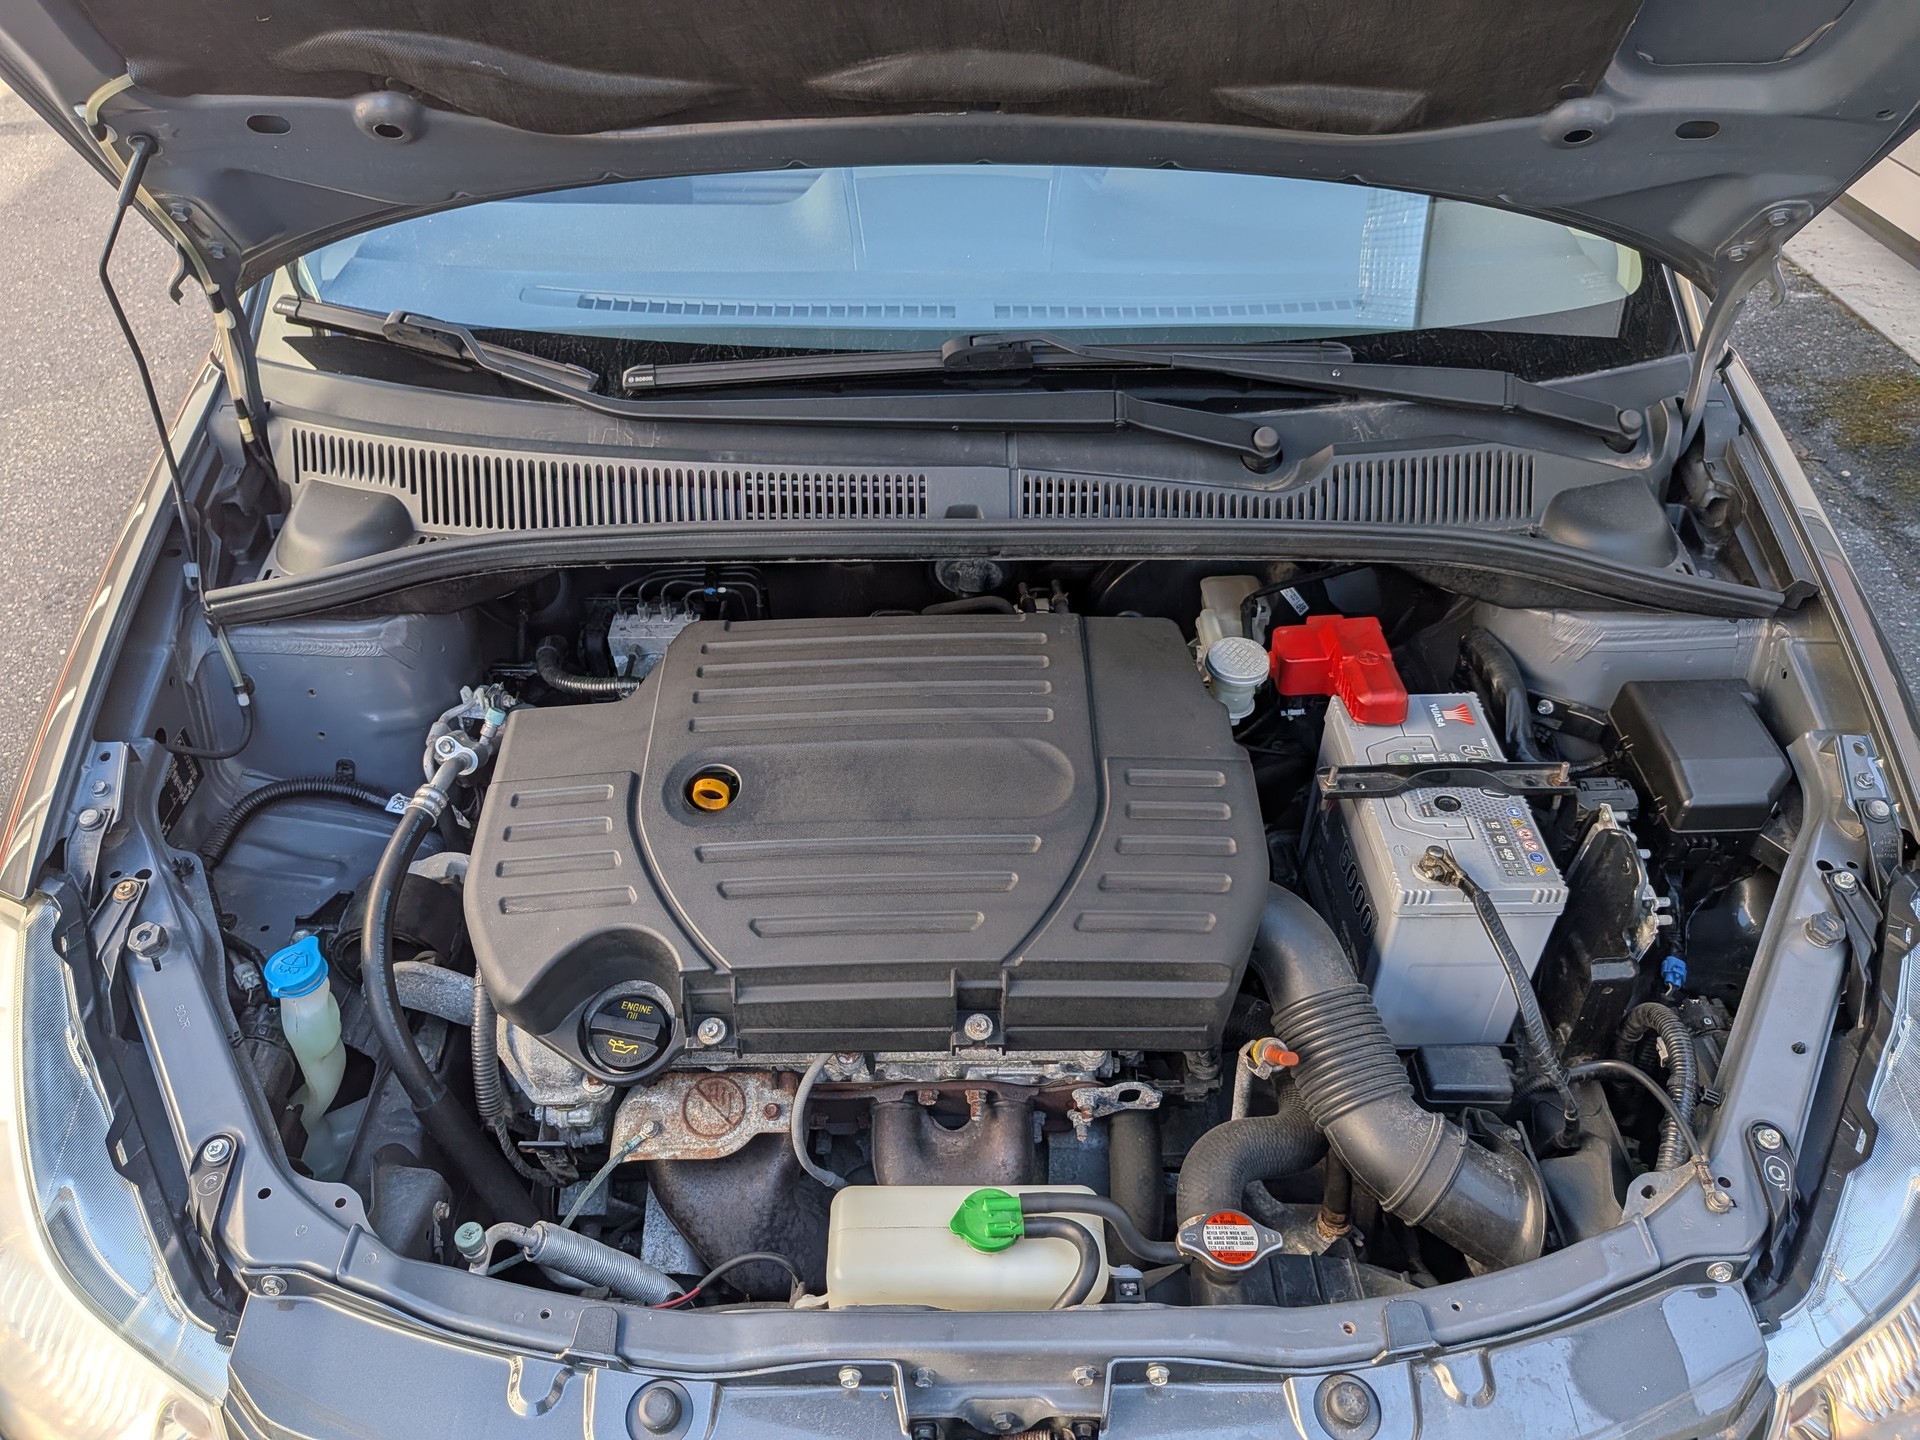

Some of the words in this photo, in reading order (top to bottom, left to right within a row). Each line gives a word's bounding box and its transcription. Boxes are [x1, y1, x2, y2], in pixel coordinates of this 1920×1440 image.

[1429, 703, 1446, 728] YUASA
[1490, 821, 1501, 830] 12
[1503, 848, 1516, 861] 450
[1339, 840, 1373, 937] 5000
[621, 1001, 653, 1014] ENGINE
